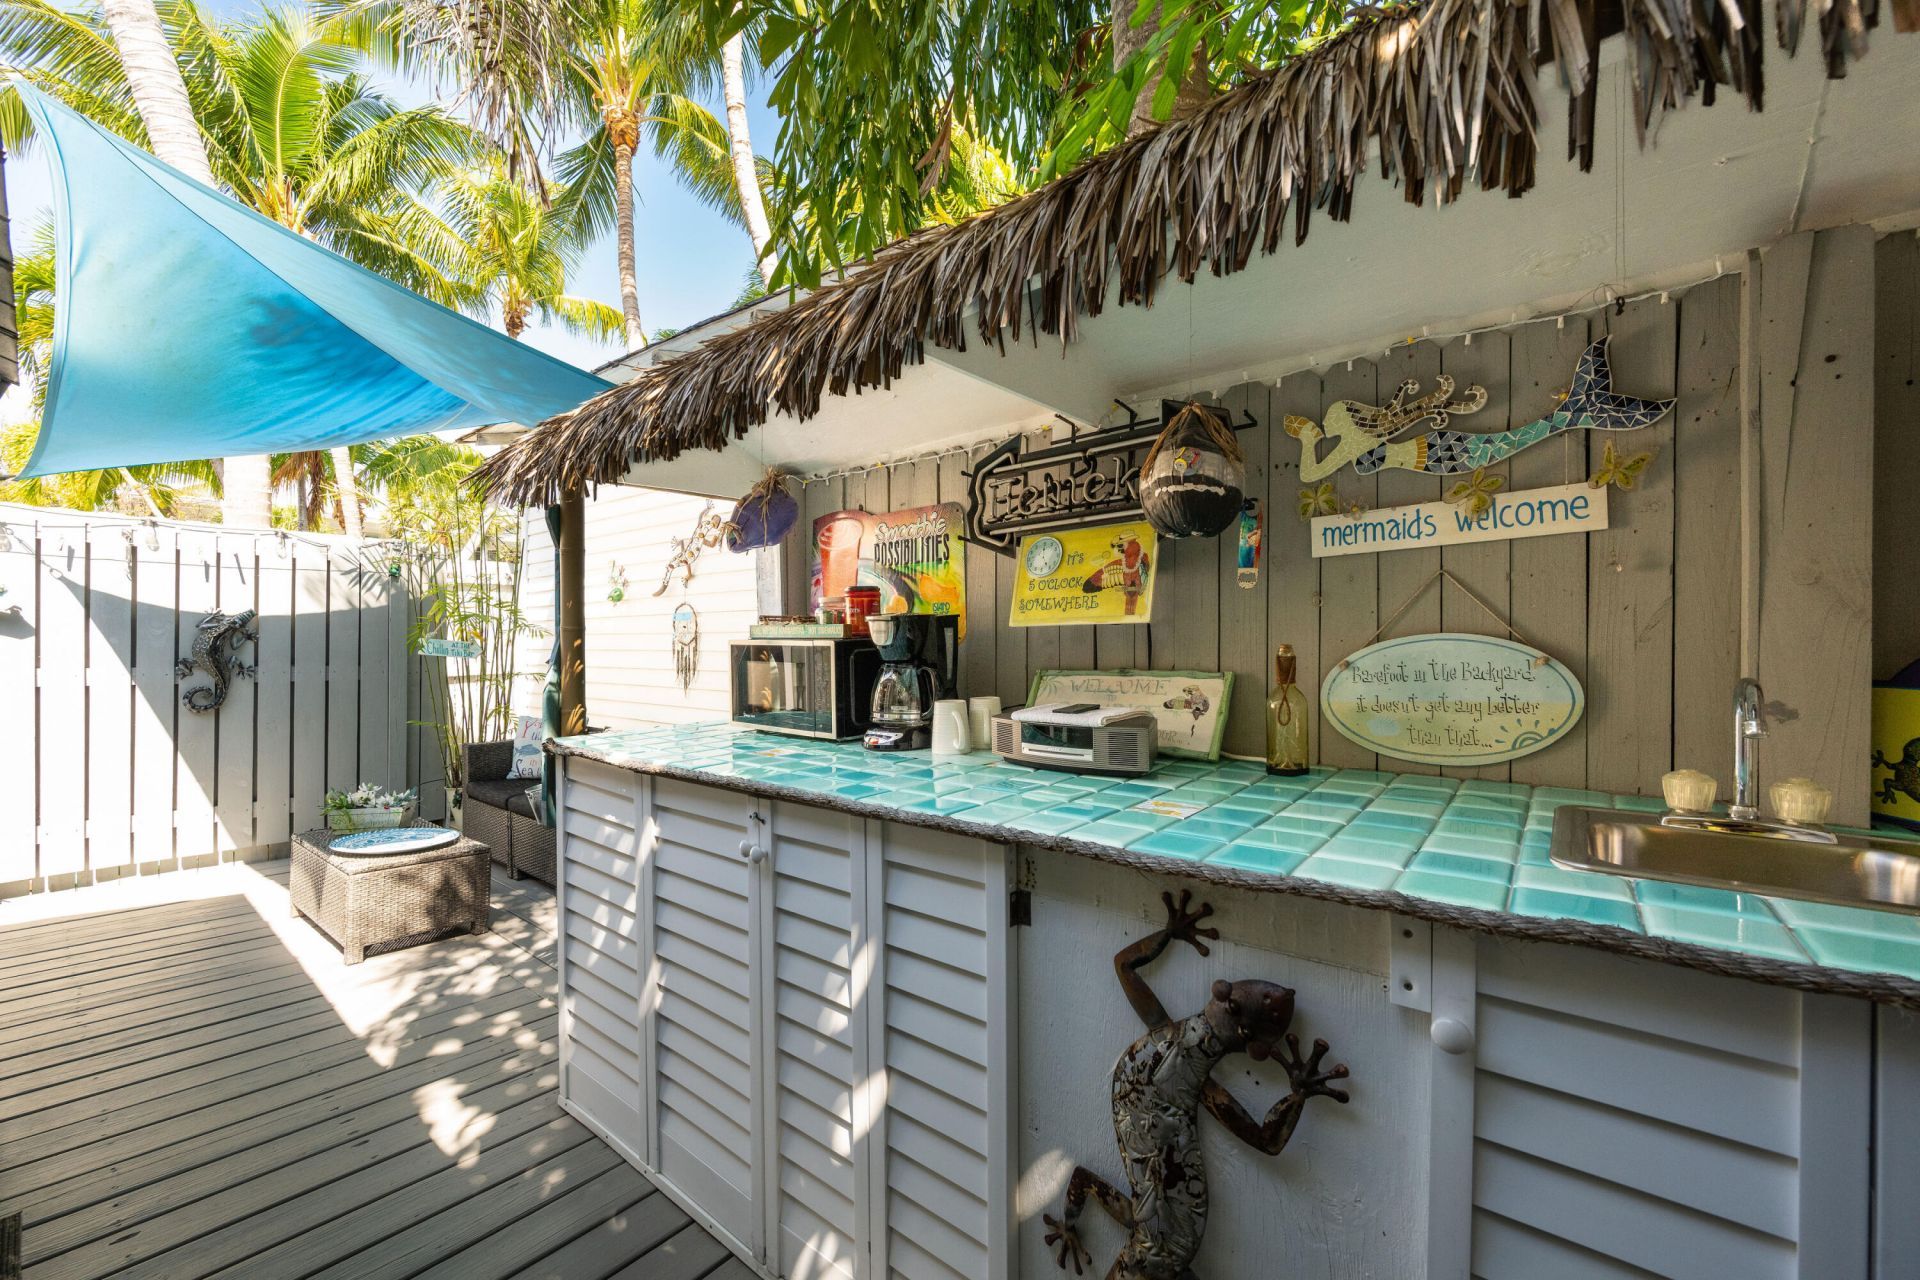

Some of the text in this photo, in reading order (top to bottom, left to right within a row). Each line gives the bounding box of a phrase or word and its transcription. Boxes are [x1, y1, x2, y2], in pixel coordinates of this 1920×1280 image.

[986, 456, 1141, 523] Heinek
[875, 511, 947, 541] Smoothie
[1321, 495, 1590, 548] mermaids welcome
[874, 533, 950, 567] POSSIBILITIES
[1028, 578, 1036, 592] 5
[1018, 594, 1099, 613] SOMEWHERE
[1351, 659, 1410, 684] Barefoot
[1413, 669, 1426, 683] in
[1427, 658, 1458, 682] the
[1069, 678, 1172, 696] WELCOME
[1356, 694, 1368, 714] it
[1424, 692, 1451, 723] get
[1454, 700, 1483, 723] any
[1487, 692, 1541, 716] better
[1406, 724, 1442, 746] than
